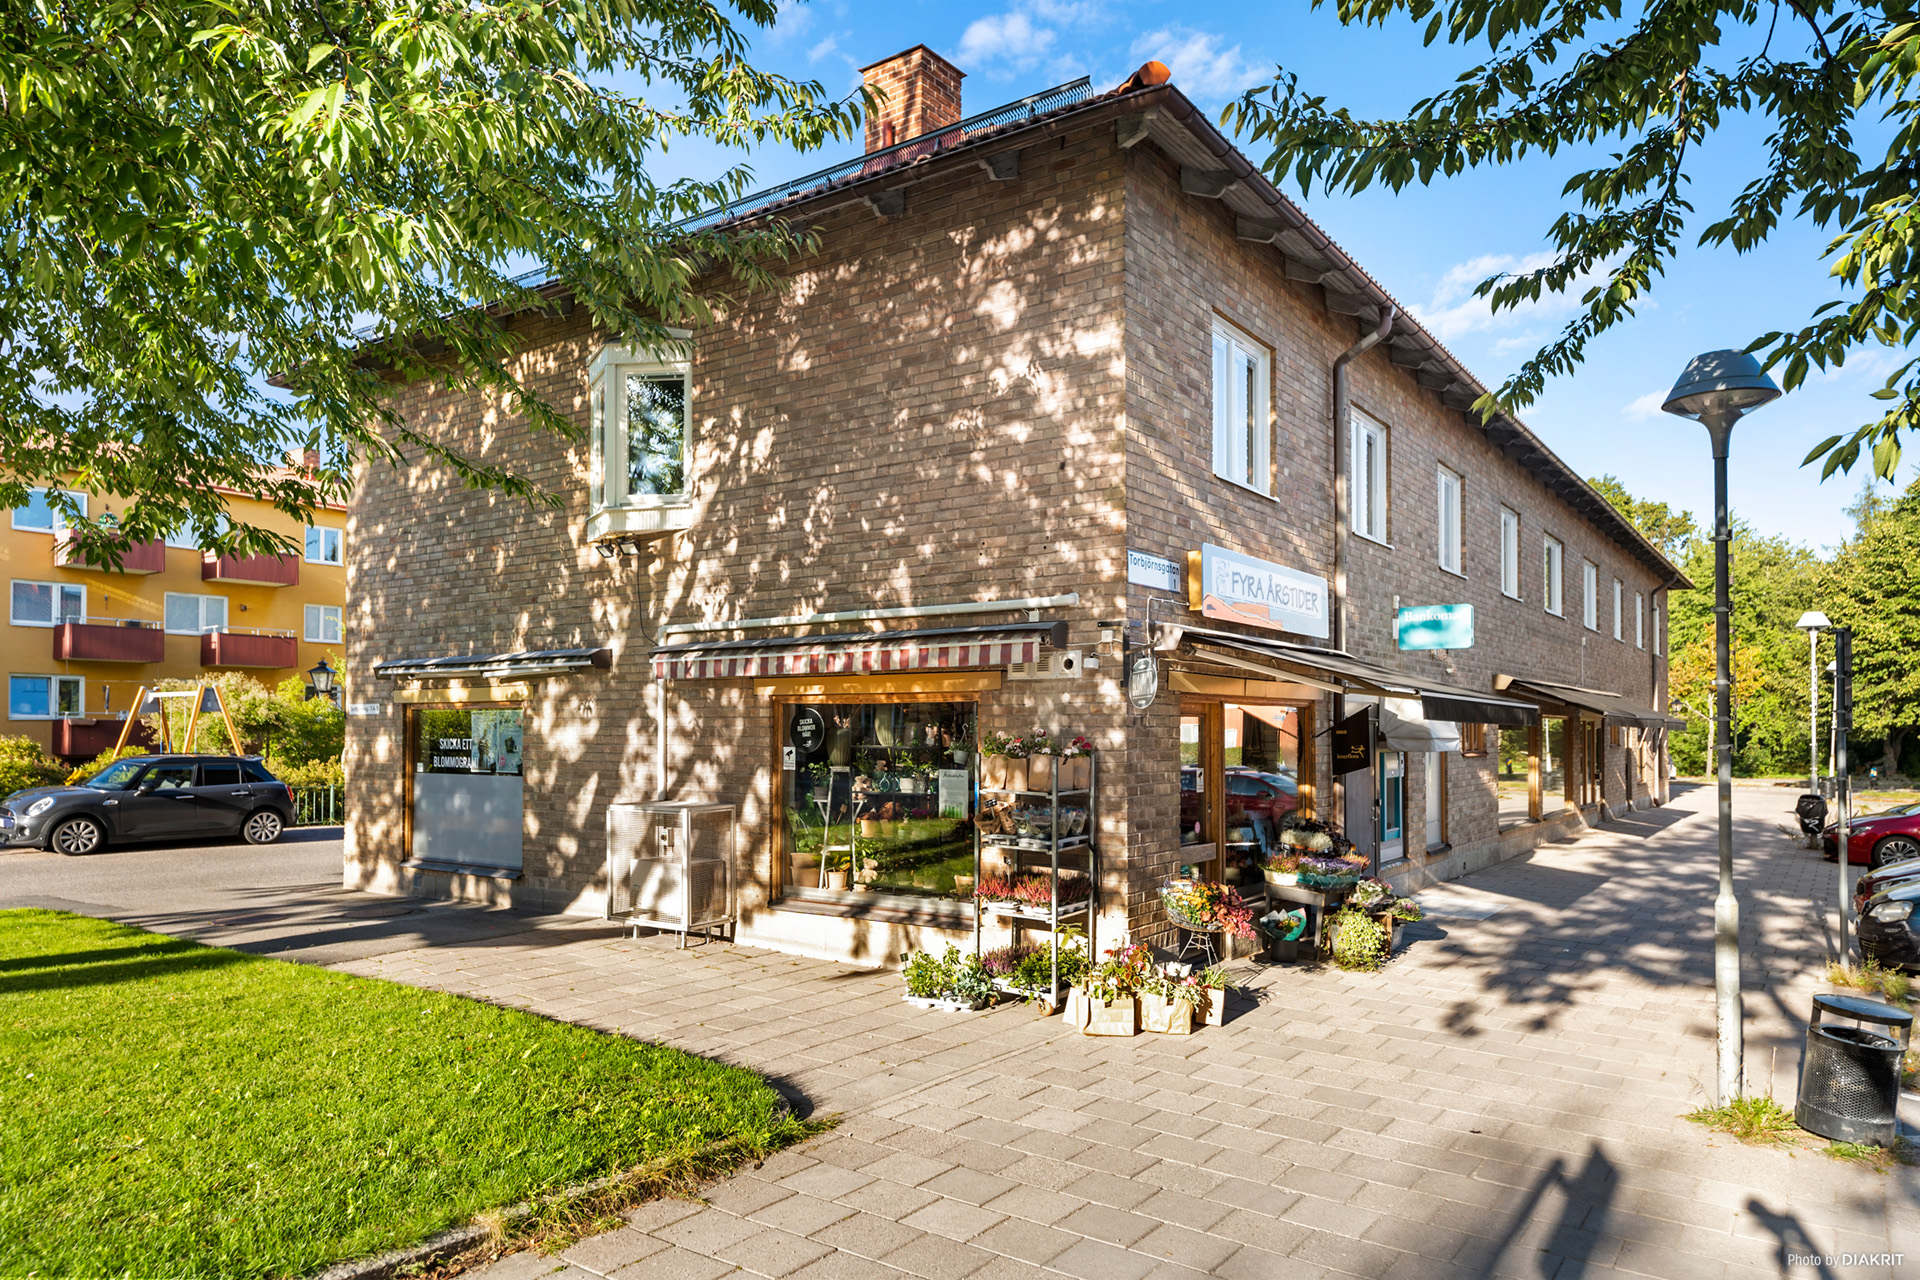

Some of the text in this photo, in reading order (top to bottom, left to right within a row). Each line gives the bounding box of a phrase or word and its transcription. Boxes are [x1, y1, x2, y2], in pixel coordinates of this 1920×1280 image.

[1129, 553, 1180, 576] Torbjörnsgatan
[1173, 578, 1177, 590] 1
[1232, 571, 1319, 613] FYRA ÅRSTIDER
[1404, 609, 1464, 622] Bankoma
[439, 738, 472, 750] SKICKA ETT
